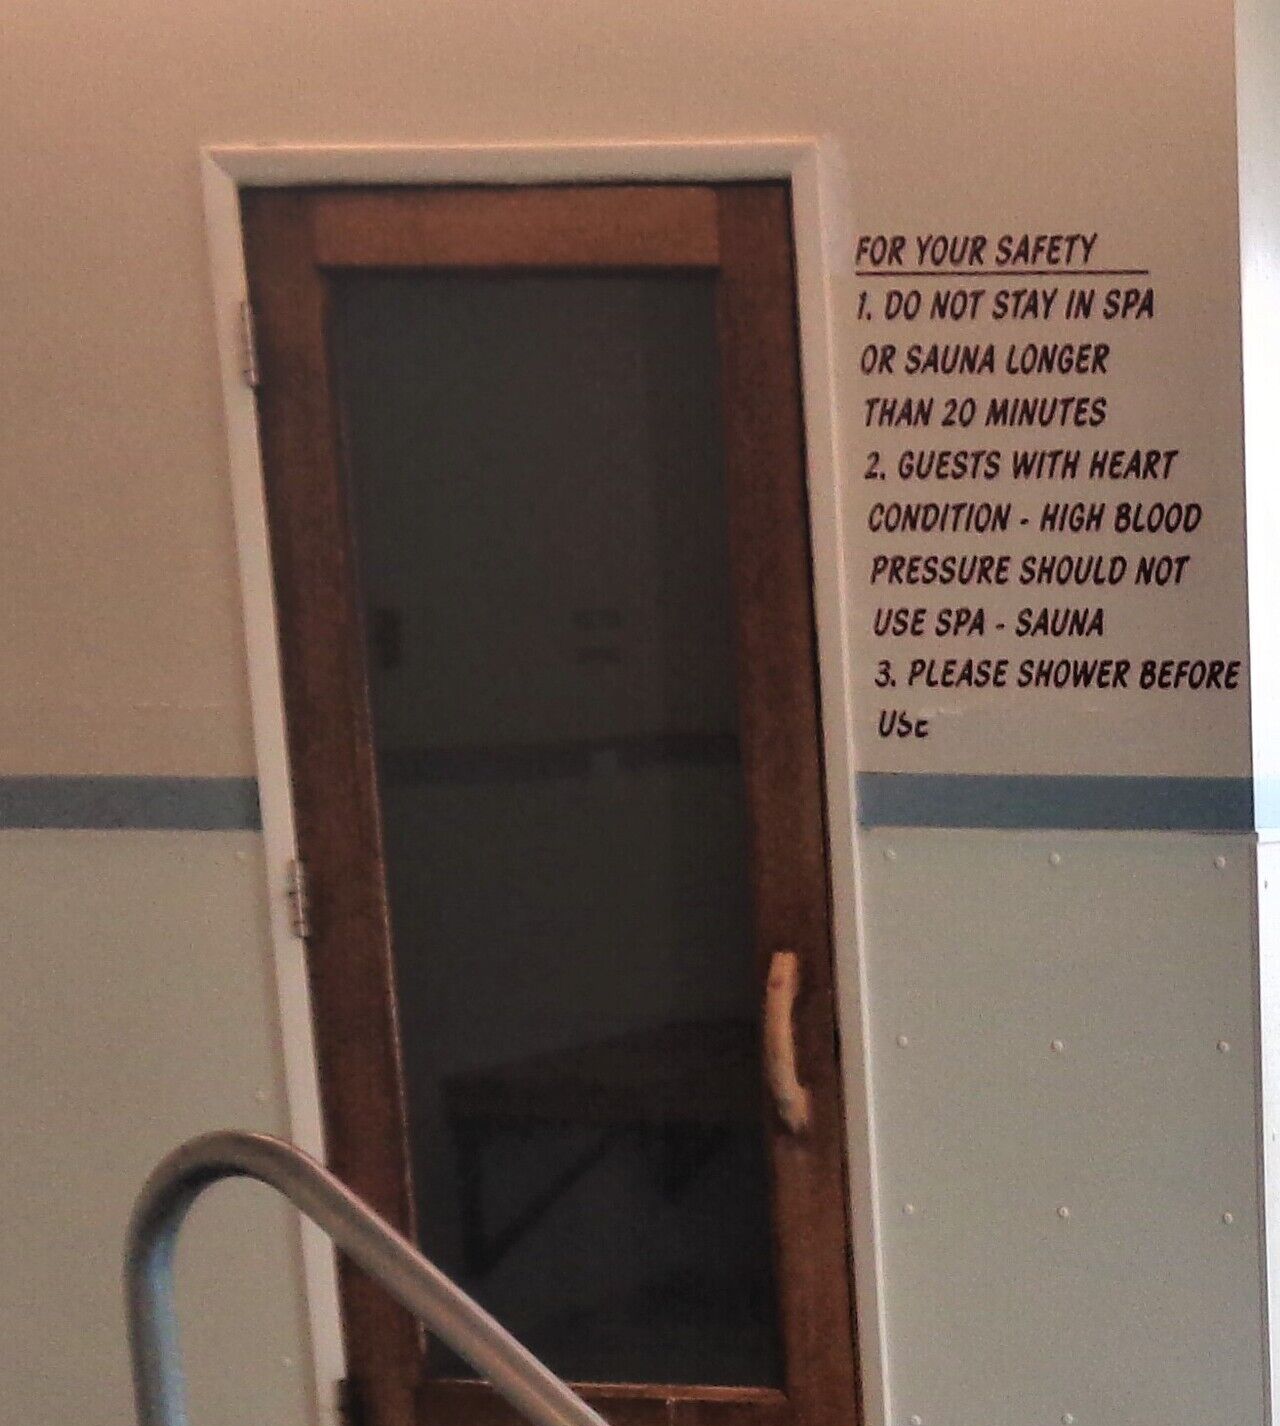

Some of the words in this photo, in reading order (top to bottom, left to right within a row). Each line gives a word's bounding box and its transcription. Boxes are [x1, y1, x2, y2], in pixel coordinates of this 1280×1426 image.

[856, 235, 907, 268] FOR
[916, 234, 988, 267] YOUR
[995, 232, 1099, 267] SAFETY
[857, 290, 872, 322] 1.
[884, 289, 922, 322] DO
[929, 289, 986, 322] NOT
[991, 288, 1059, 321] STAY
[1064, 288, 1096, 320] IN
[1102, 287, 1155, 321] SPA
[860, 343, 897, 376] OR
[904, 343, 996, 376] SAUNA
[1005, 342, 1111, 376] LONGER
[864, 396, 934, 428] THAN
[940, 397, 977, 429] 20
[984, 396, 1107, 428] MINUTES
[863, 450, 886, 481] 2.
[897, 449, 1002, 481] GUESTS
[1012, 449, 1082, 481] WITH
[1088, 448, 1180, 481] HEART
[867, 502, 1012, 534] CONDITION
[1039, 501, 1106, 534] HIGH
[1113, 501, 1203, 534] BLOOD
[870, 553, 1012, 586] PRESSURE
[1018, 554, 1128, 586] SHOULD
[1134, 554, 1191, 587] NOT
[873, 607, 927, 637] USE
[934, 607, 986, 638] SPA
[1014, 607, 1105, 638] SAUNA
[874, 659, 898, 689] 3.
[907, 658, 1010, 689] PLEASE
[1016, 658, 1132, 689] SHOWER
[1138, 659, 1242, 691] BEFORE
